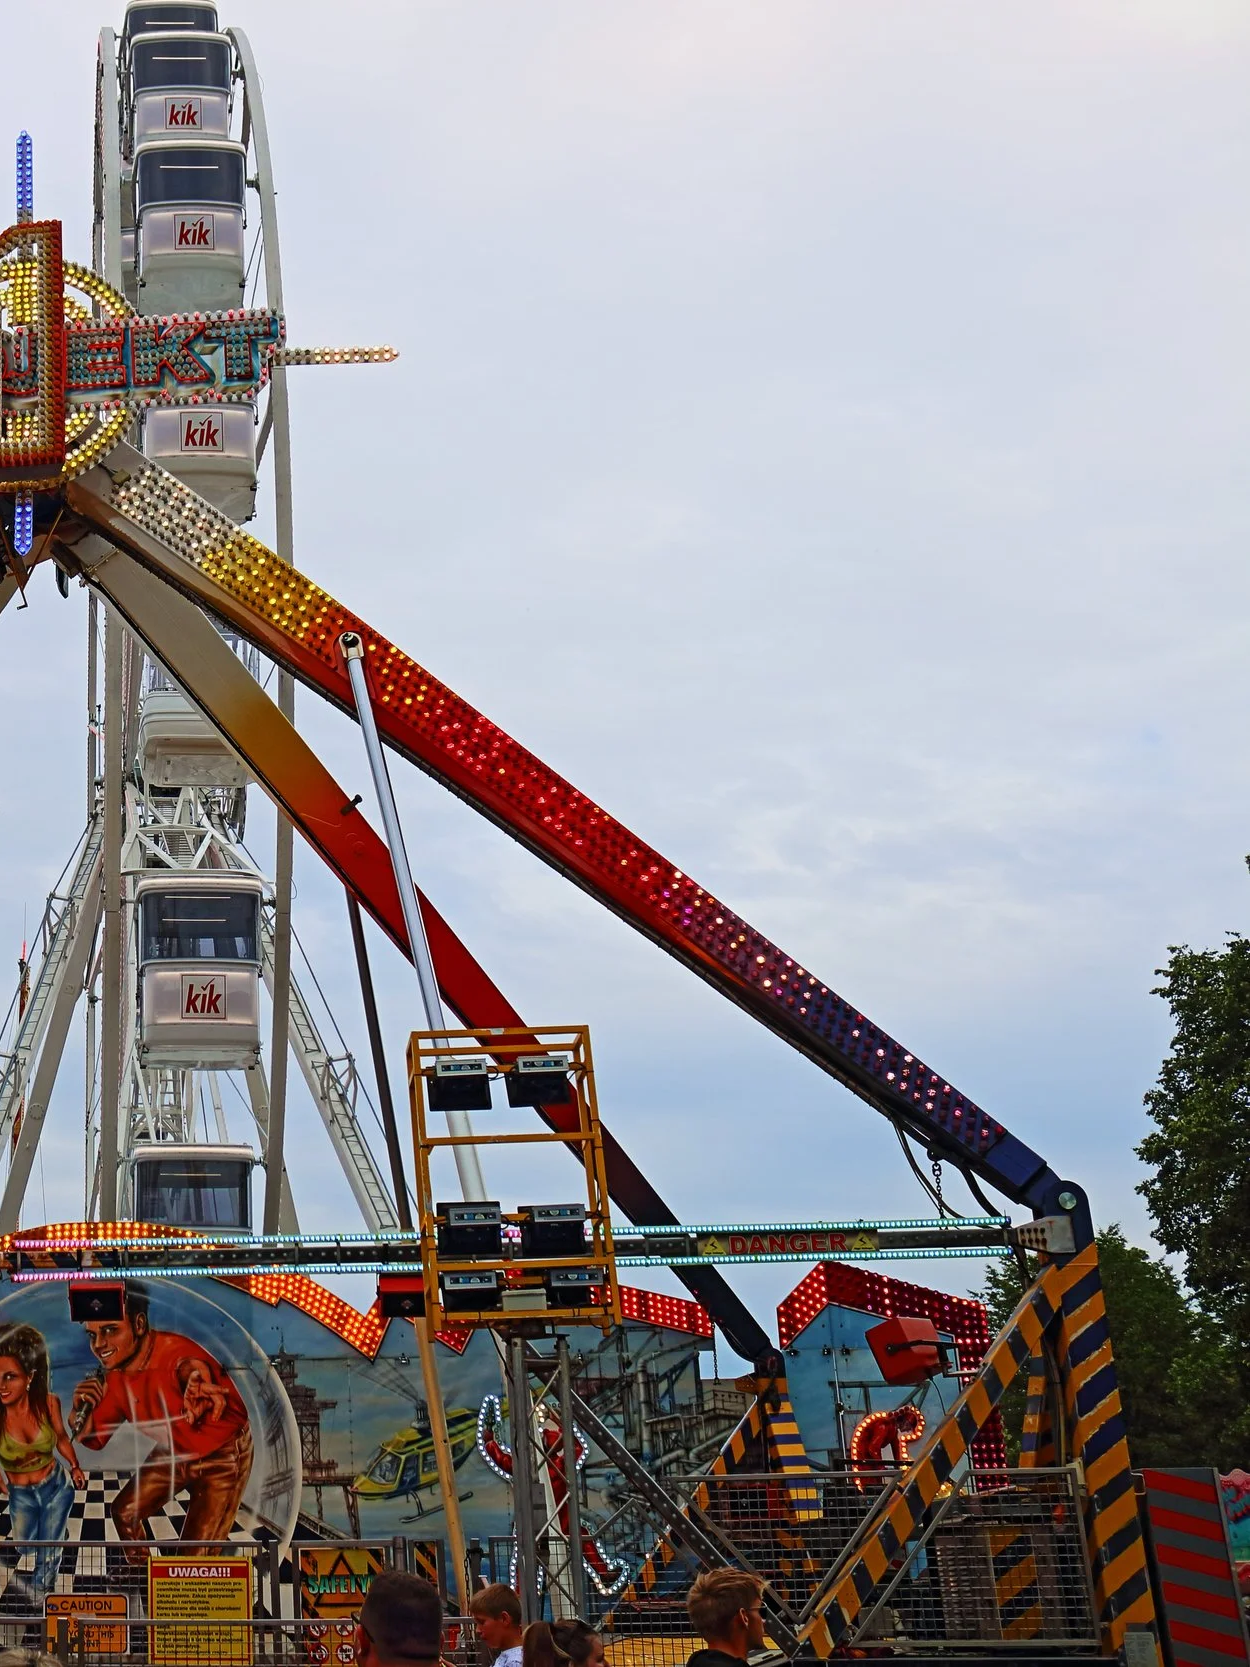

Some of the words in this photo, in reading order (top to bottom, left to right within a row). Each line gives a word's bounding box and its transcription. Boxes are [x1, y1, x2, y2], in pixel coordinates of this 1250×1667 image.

[168, 101, 197, 126] kik
[178, 218, 210, 246] kik
[184, 417, 219, 448] kik
[186, 981, 222, 1014] kik
[729, 1233, 848, 1255] DANGER
[168, 1567, 231, 1578] UWAGA!!!
[60, 1601, 112, 1611] CAUTION
